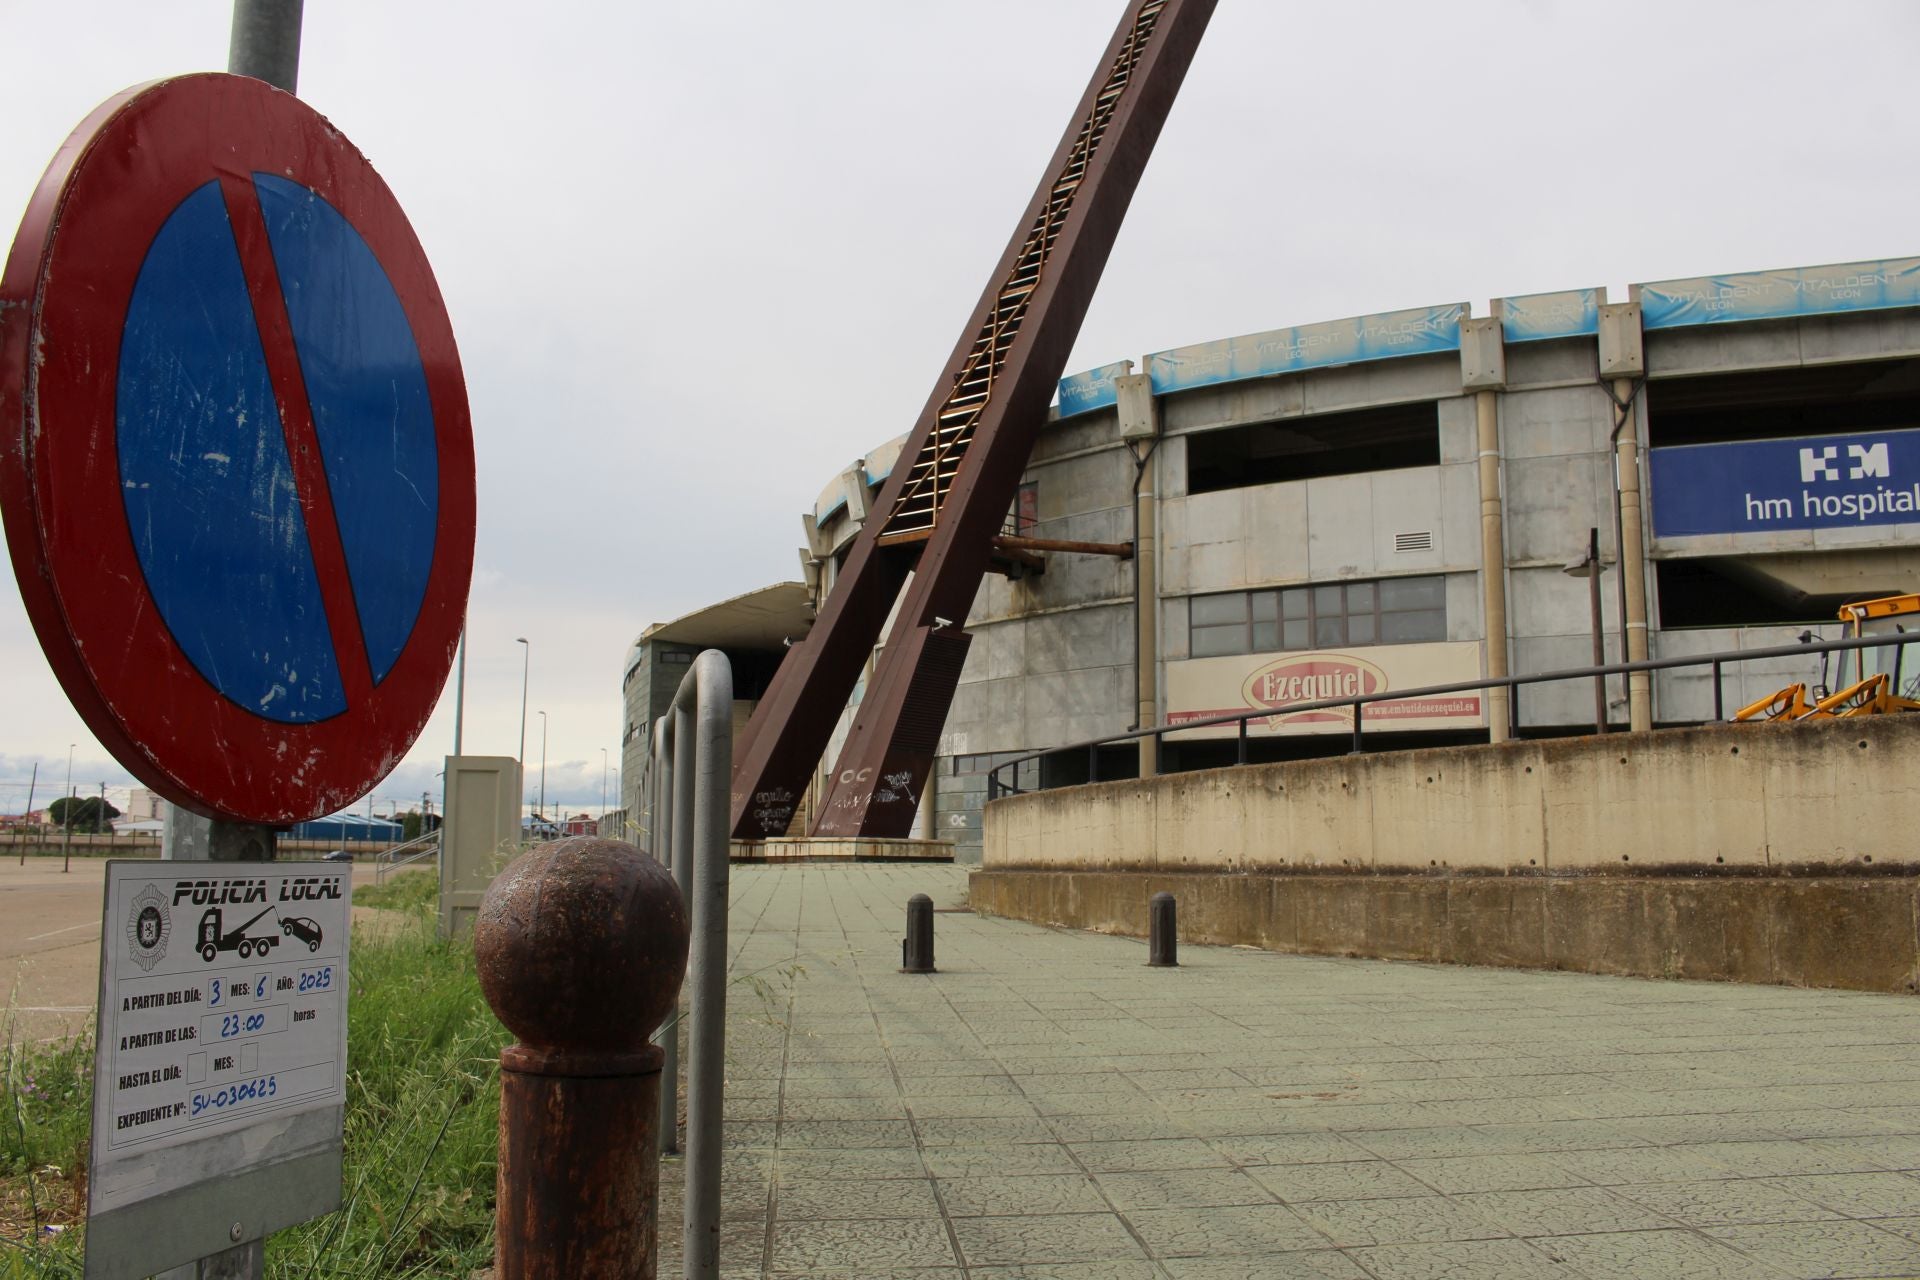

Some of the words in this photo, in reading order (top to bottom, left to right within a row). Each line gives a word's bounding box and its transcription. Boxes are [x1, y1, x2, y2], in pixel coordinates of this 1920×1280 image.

[1666, 283, 1774, 304] VITALDENT
[1789, 273, 1901, 292] VITALDENT
[1353, 317, 1448, 339] VITALDENT
[1253, 332, 1342, 354] VITALDENT
[1745, 493, 1793, 521] hm
[1262, 667, 1365, 701] Ezequiel
[172, 879, 267, 907] POLICIA
[278, 877, 342, 902] LOCAL
[123, 998, 130, 1012] A
[131, 992, 165, 1010] PARTIR
[166, 990, 182, 1006] DEL
[184, 987, 202, 1004] DÍA:
[210, 979, 221, 1005] 3
[230, 982, 250, 997] MES:
[256, 975, 267, 998] 6
[276, 976, 295, 991] AÑO:
[298, 967, 332, 992] 2025
[120, 1037, 127, 1051] A
[129, 1031, 163, 1050] PARTIR
[165, 1029, 177, 1043] DE
[178, 1026, 197, 1041] LAS:
[221, 1013, 265, 1038] 23:00
[293, 1009, 316, 1022] horas
[119, 1071, 150, 1090] HASTA
[151, 1069, 162, 1083] EL
[163, 1064, 182, 1080] DÍA:
[213, 1056, 234, 1071] MES:
[117, 1104, 172, 1130] EXPEDIENTE
